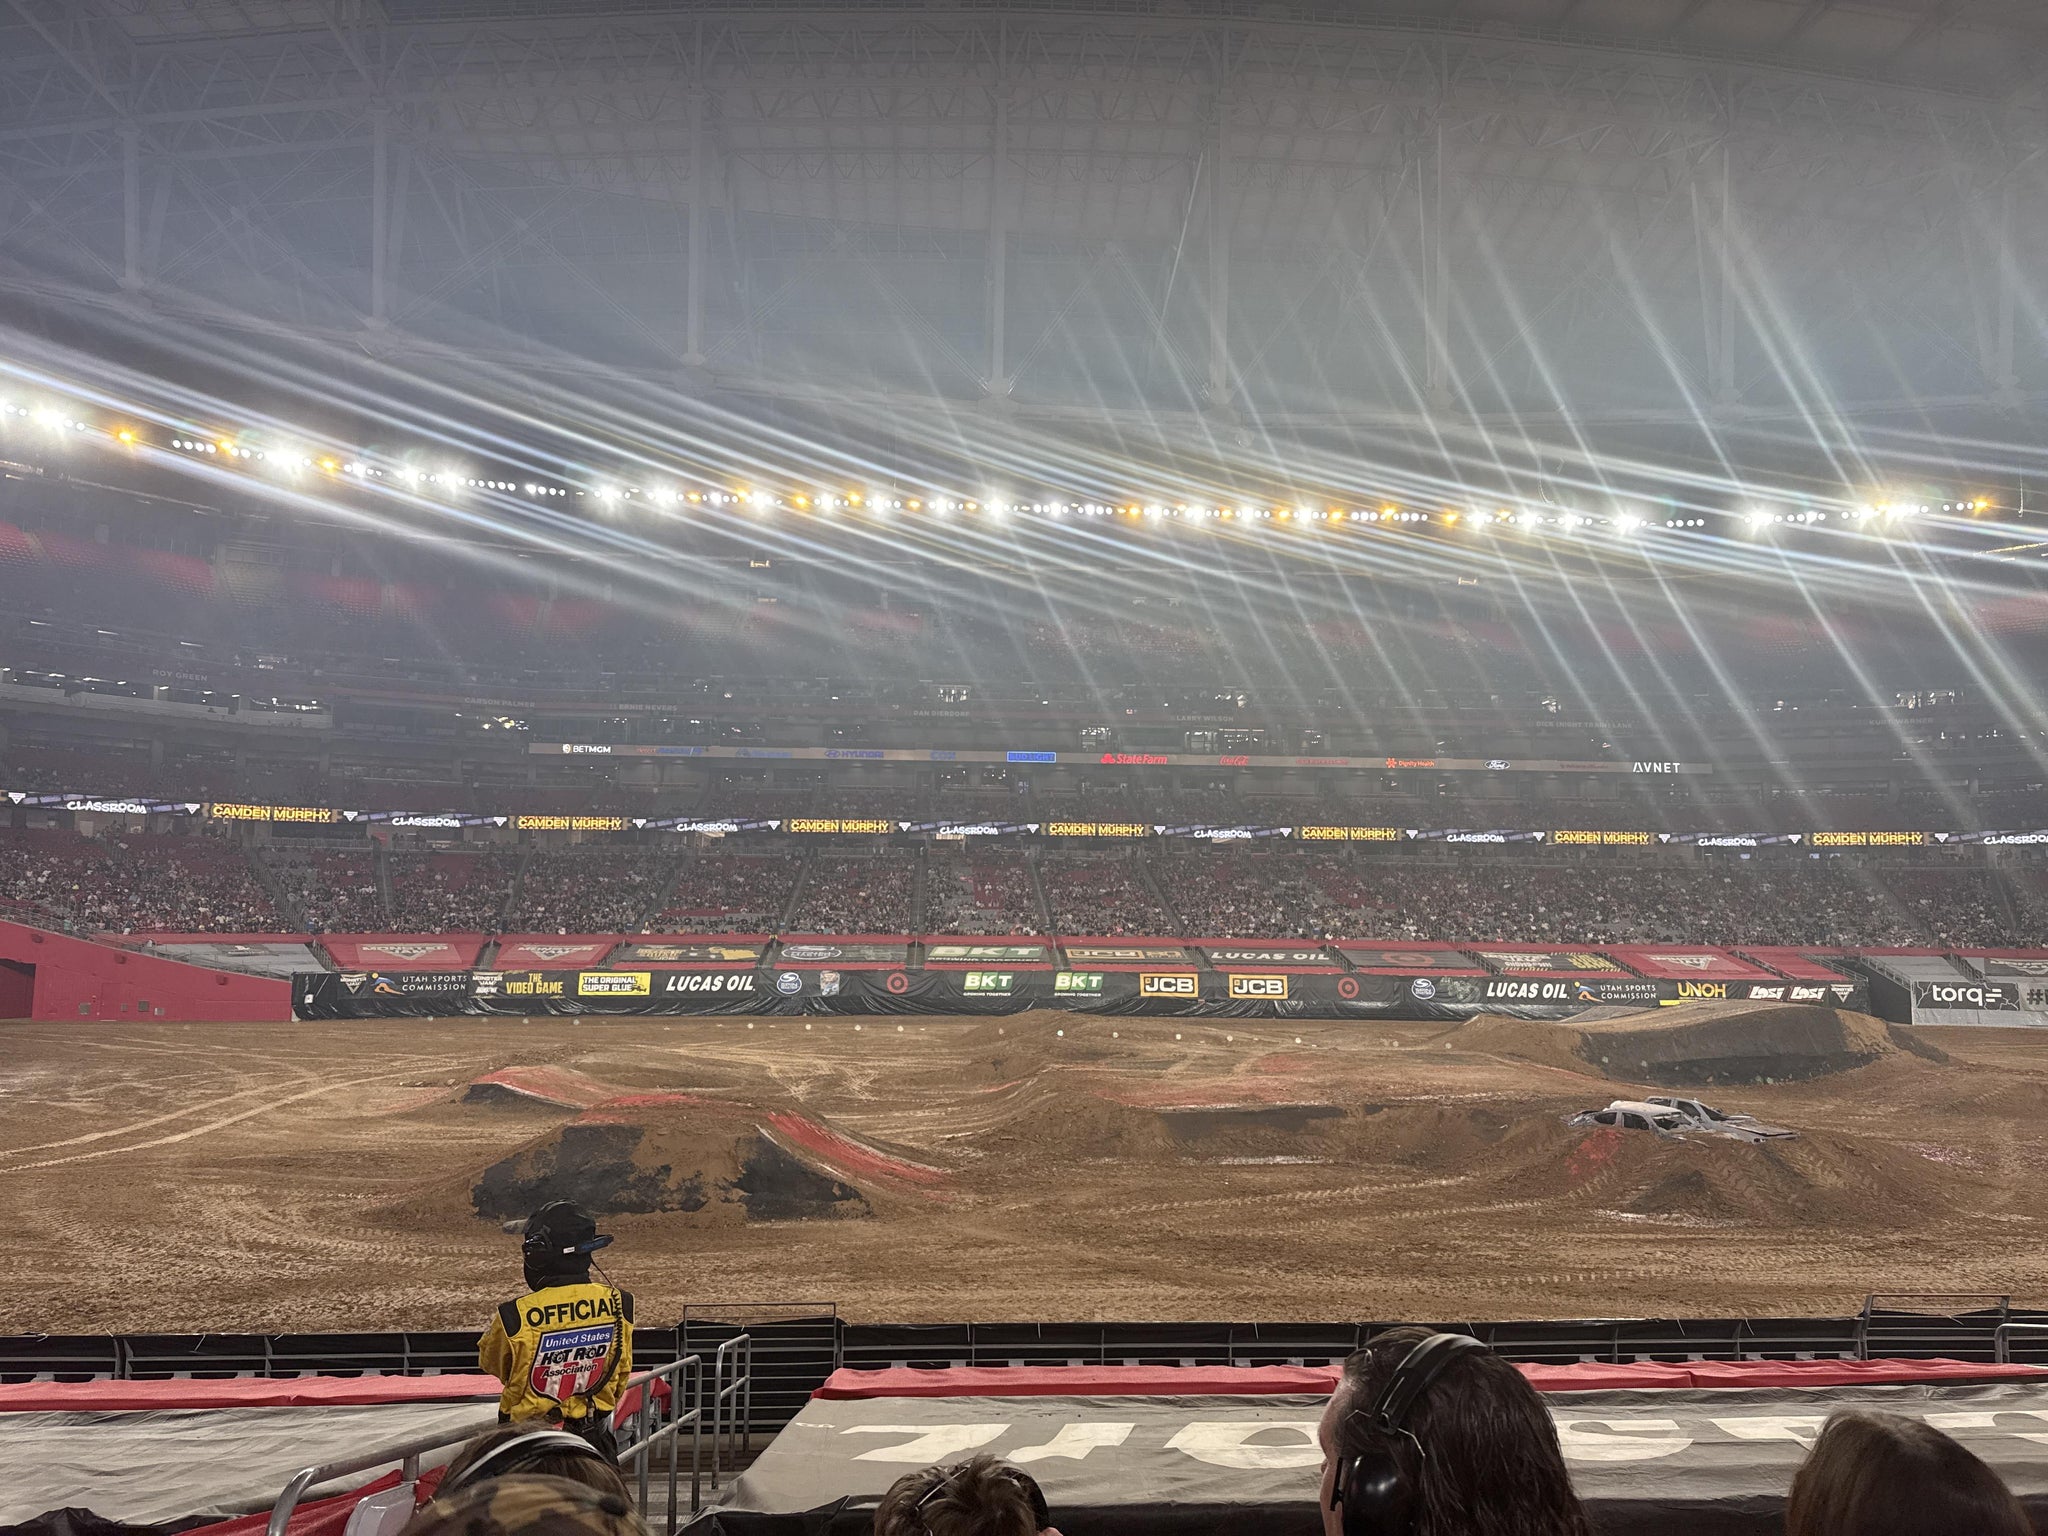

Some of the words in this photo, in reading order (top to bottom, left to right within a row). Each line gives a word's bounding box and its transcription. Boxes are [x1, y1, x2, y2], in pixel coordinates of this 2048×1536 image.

[175, 671, 208, 681] GREEN
[573, 745, 612, 754] BETMGM
[841, 750, 885, 759] HYUNDAI
[1632, 762, 1681, 773] AVNET
[67, 801, 147, 814] CLASSROOM
[213, 806, 271, 817] CAMDEN
[273, 808, 332, 820] MURPHY
[392, 817, 461, 828] CLASSROOM
[518, 819, 570, 828] CAMDEN
[572, 819, 622, 828] MURPHY
[677, 822, 738, 832] CLASSROOM
[791, 822, 839, 831] CAMDEN
[842, 822, 889, 831] MURPHY
[940, 826, 999, 835] CLASSROOM
[1050, 825, 1096, 834] CAMDEN
[1098, 825, 1144, 834] MURPHY
[1193, 830, 1251, 839] CLASSROOM
[1302, 829, 1348, 838] CAMDEN
[1350, 830, 1397, 838] MURPHY
[1447, 834, 1505, 843] CLASSROOM
[1555, 833, 1601, 842] CAMDEN
[1604, 833, 1650, 843] MURPHY
[1698, 838, 1757, 847] CLASSROOM
[1813, 835, 1866, 843] CAMDEN
[1869, 834, 1923, 843] MURPHY
[1983, 834, 2048, 844] CLASSROO
[1211, 952, 1286, 960] LUCAS
[433, 975, 468, 983] SPORTS
[528, 973, 543, 983] THE
[583, 976, 599, 984] THE
[600, 976, 637, 984] ORIGINAL
[666, 975, 724, 991] LUCAS
[965, 975, 1012, 987] BKT
[1056, 975, 1102, 988] BKT
[506, 982, 533, 994] VIDEO
[536, 982, 563, 994] GAME
[582, 984, 610, 992] SUPER
[611, 984, 633, 992] GLUE
[1145, 977, 1194, 992] JCB
[1234, 979, 1284, 994] JCB
[1677, 980, 1727, 998] UNOH
[1487, 982, 1539, 998] LUCAS
[526, 1298, 618, 1327] OFFICIAL
[546, 1335, 579, 1348] United
[580, 1332, 610, 1343] States
[541, 1348, 573, 1365] HOT
[574, 1344, 607, 1361] ROD
[542, 1363, 598, 1378] Association
